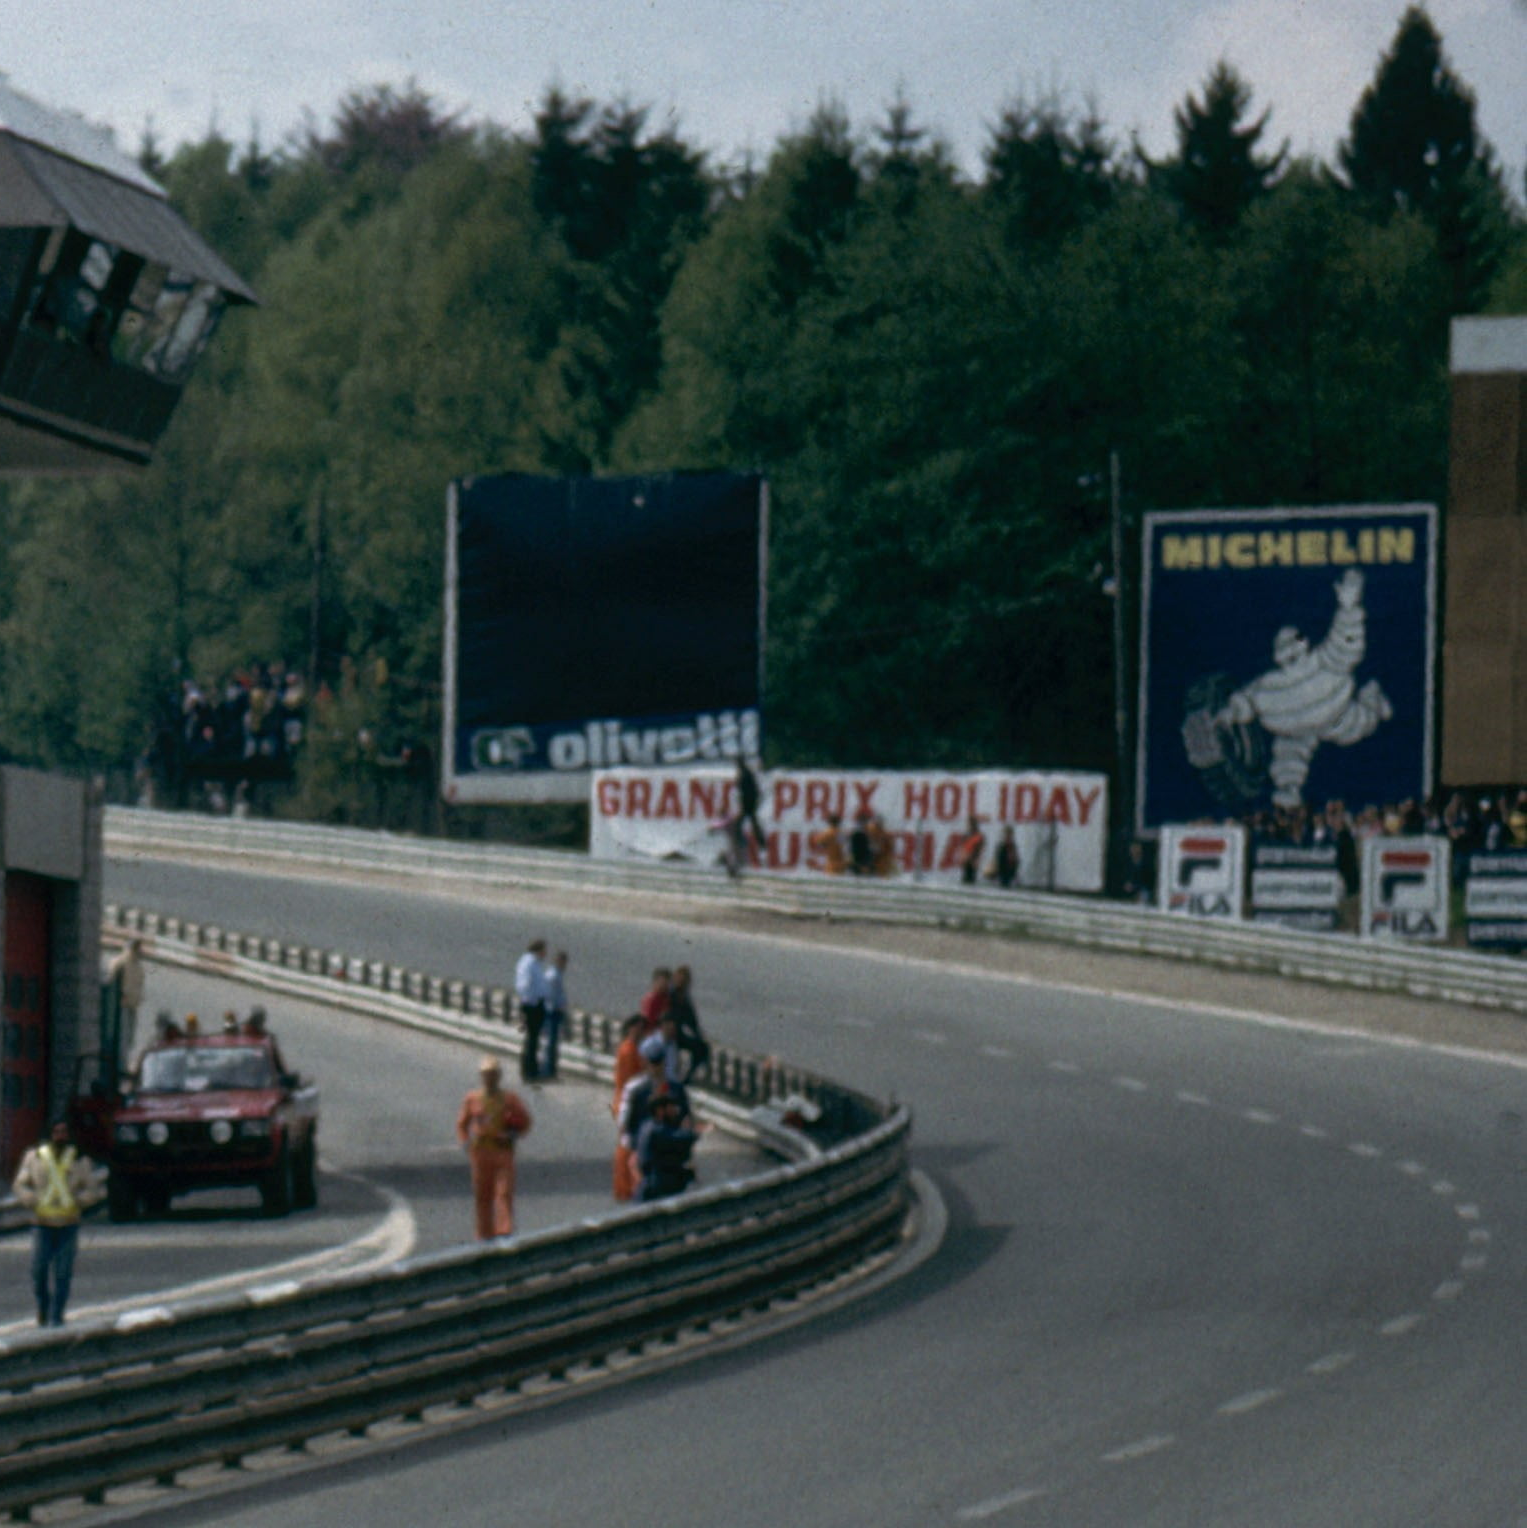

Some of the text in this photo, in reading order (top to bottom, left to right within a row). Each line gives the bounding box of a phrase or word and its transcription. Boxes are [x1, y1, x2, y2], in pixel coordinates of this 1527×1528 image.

[1161, 527, 1415, 569] MICHELIN
[547, 707, 760, 770] olivetti
[773, 779, 880, 821] PRIX
[903, 780, 1102, 826] HOLIDAY
[1169, 893, 1230, 915] FILA
[1370, 911, 1437, 935] FILA
